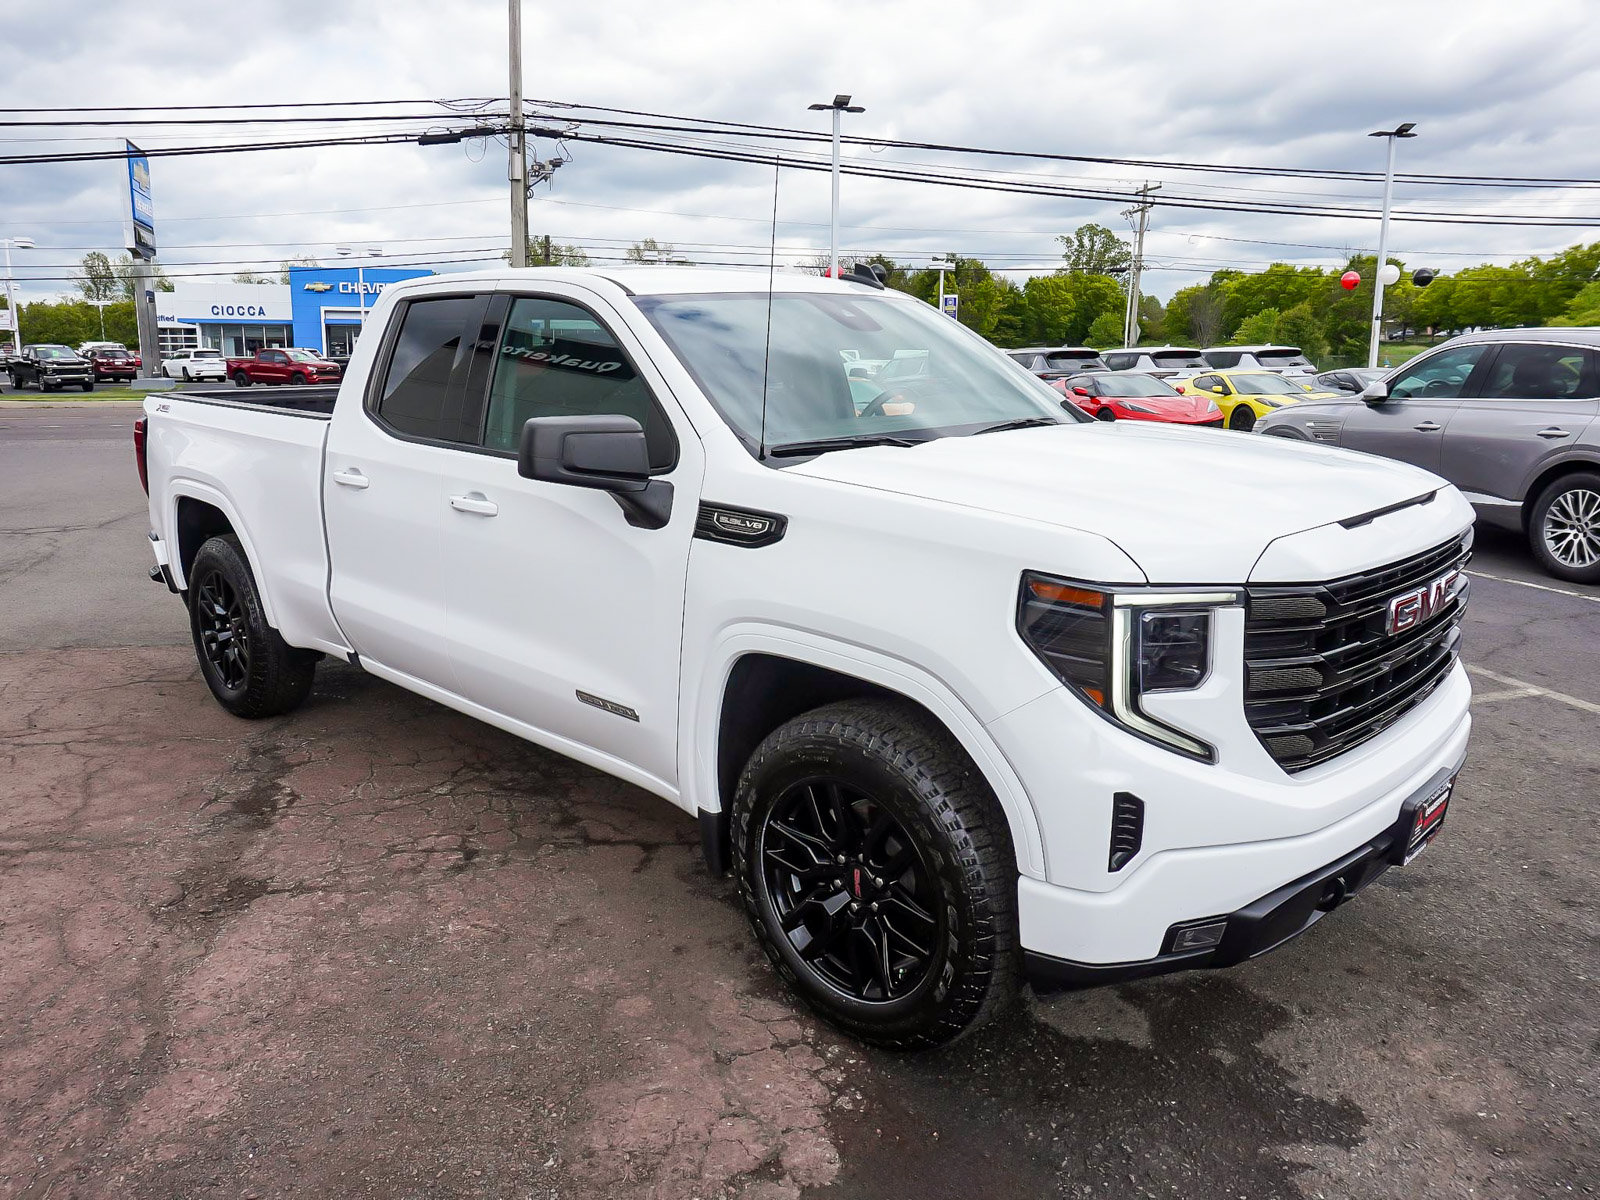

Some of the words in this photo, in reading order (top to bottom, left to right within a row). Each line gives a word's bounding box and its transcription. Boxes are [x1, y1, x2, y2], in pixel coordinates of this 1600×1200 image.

[339, 282, 385, 294] CHEVR
[211, 305, 266, 317] CIOCCA
[1387, 570, 1458, 637] GMC
